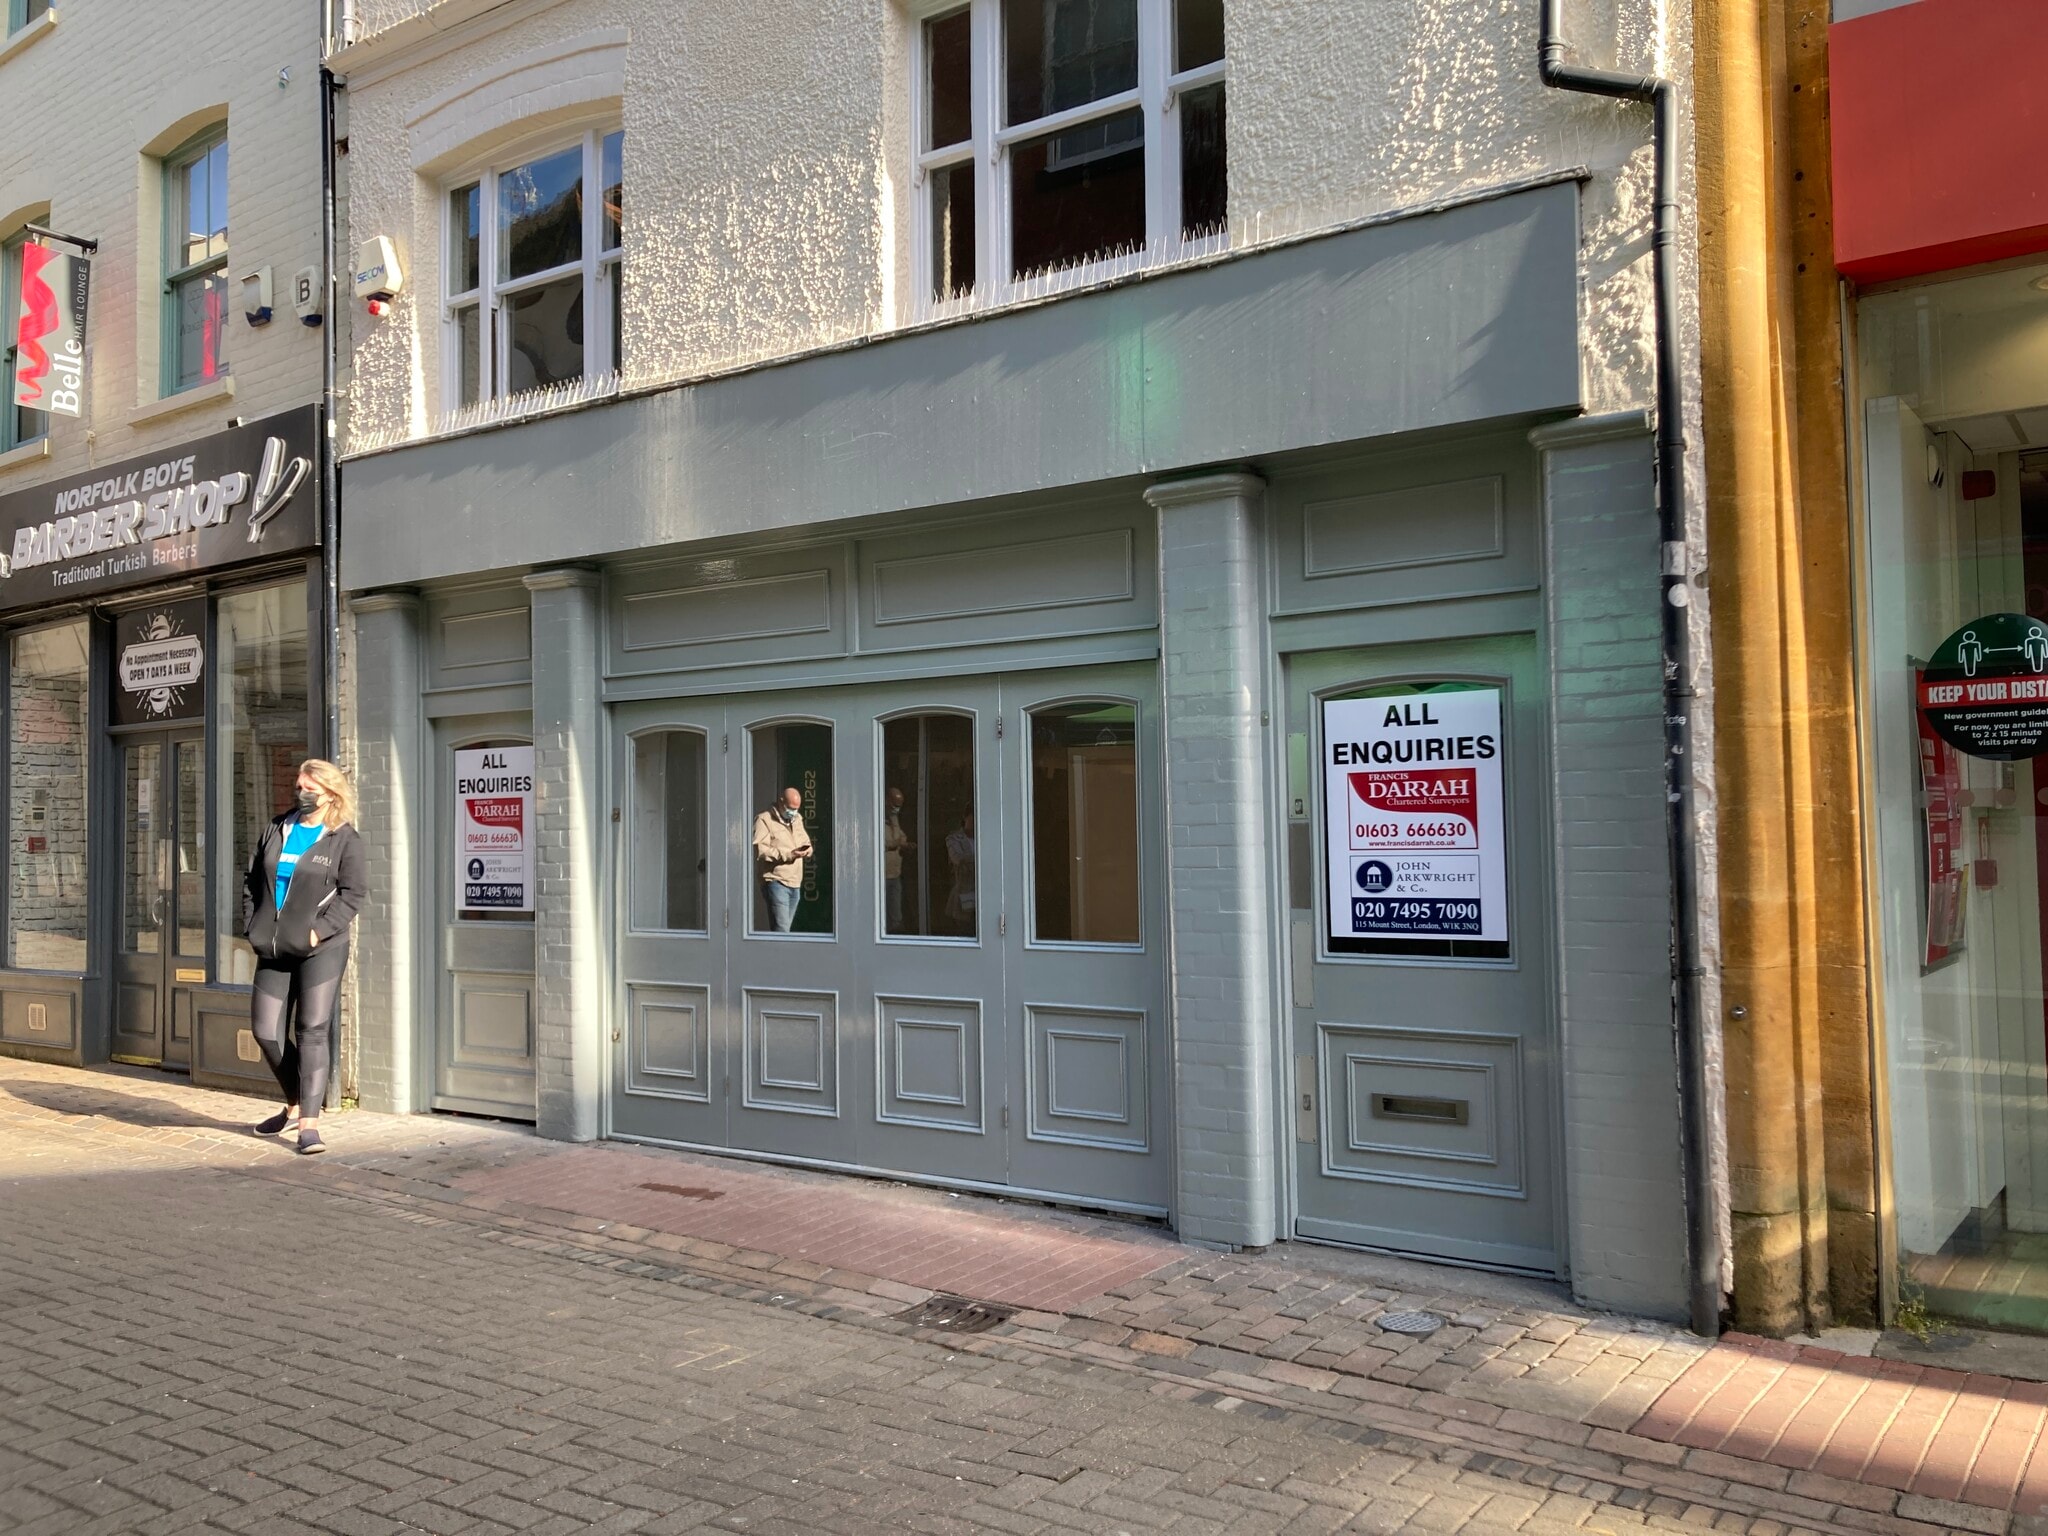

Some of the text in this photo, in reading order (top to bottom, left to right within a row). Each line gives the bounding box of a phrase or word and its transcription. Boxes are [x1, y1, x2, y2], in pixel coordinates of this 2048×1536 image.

[357, 264, 384, 284] SECOM
[300, 279, 310, 302] B
[73, 266, 87, 339] HAIR LOUNGE
[51, 339, 82, 414] Belle
[54, 455, 196, 514] NORFOLK BOYS
[11, 472, 251, 570] BARBER SHOP
[52, 543, 197, 587] Traditional Turkish Barbers
[169, 647, 197, 659] Necessary
[129, 661, 191, 681] OPEN 7 DAYS A WEEK
[1928, 685, 1963, 704] KEEP
[1966, 682, 2008, 701] YOUR
[1383, 703, 1439, 728] ALL
[1965, 710, 2019, 720] government
[1954, 724, 1969, 732] For
[1971, 724, 1992, 732] now,
[1993, 722, 2010, 731] you
[1972, 731, 1981, 739] to
[2011, 729, 2042, 737] minute
[1978, 737, 2037, 746] visits per day
[1333, 735, 1496, 765] ENQUIRIES
[482, 754, 507, 769] ALL
[1368, 773, 1409, 781] FRANCIS
[459, 776, 531, 794] ENQUIRIES
[1368, 779, 1470, 799] DARRAH
[1386, 796, 1470, 806] Chartered Surveyors
[474, 804, 520, 817] DARRAH
[1355, 822, 1467, 838] 01603 666630
[468, 833, 518, 843] 01603 666630
[1396, 862, 1431, 872] JOHN
[1396, 873, 1476, 882] ARKWRIGHT
[467, 886, 522, 897] 020 7495 7090
[1396, 884, 1428, 893] & Co.
[1355, 902, 1479, 920] 020 7495 7090
[1355, 920, 1367, 928] 115
[1368, 920, 1390, 929] Mount
[1391, 921, 1412, 930] Street,
[1413, 921, 1442, 931] London,
[1462, 922, 1479, 931] 3NQ
